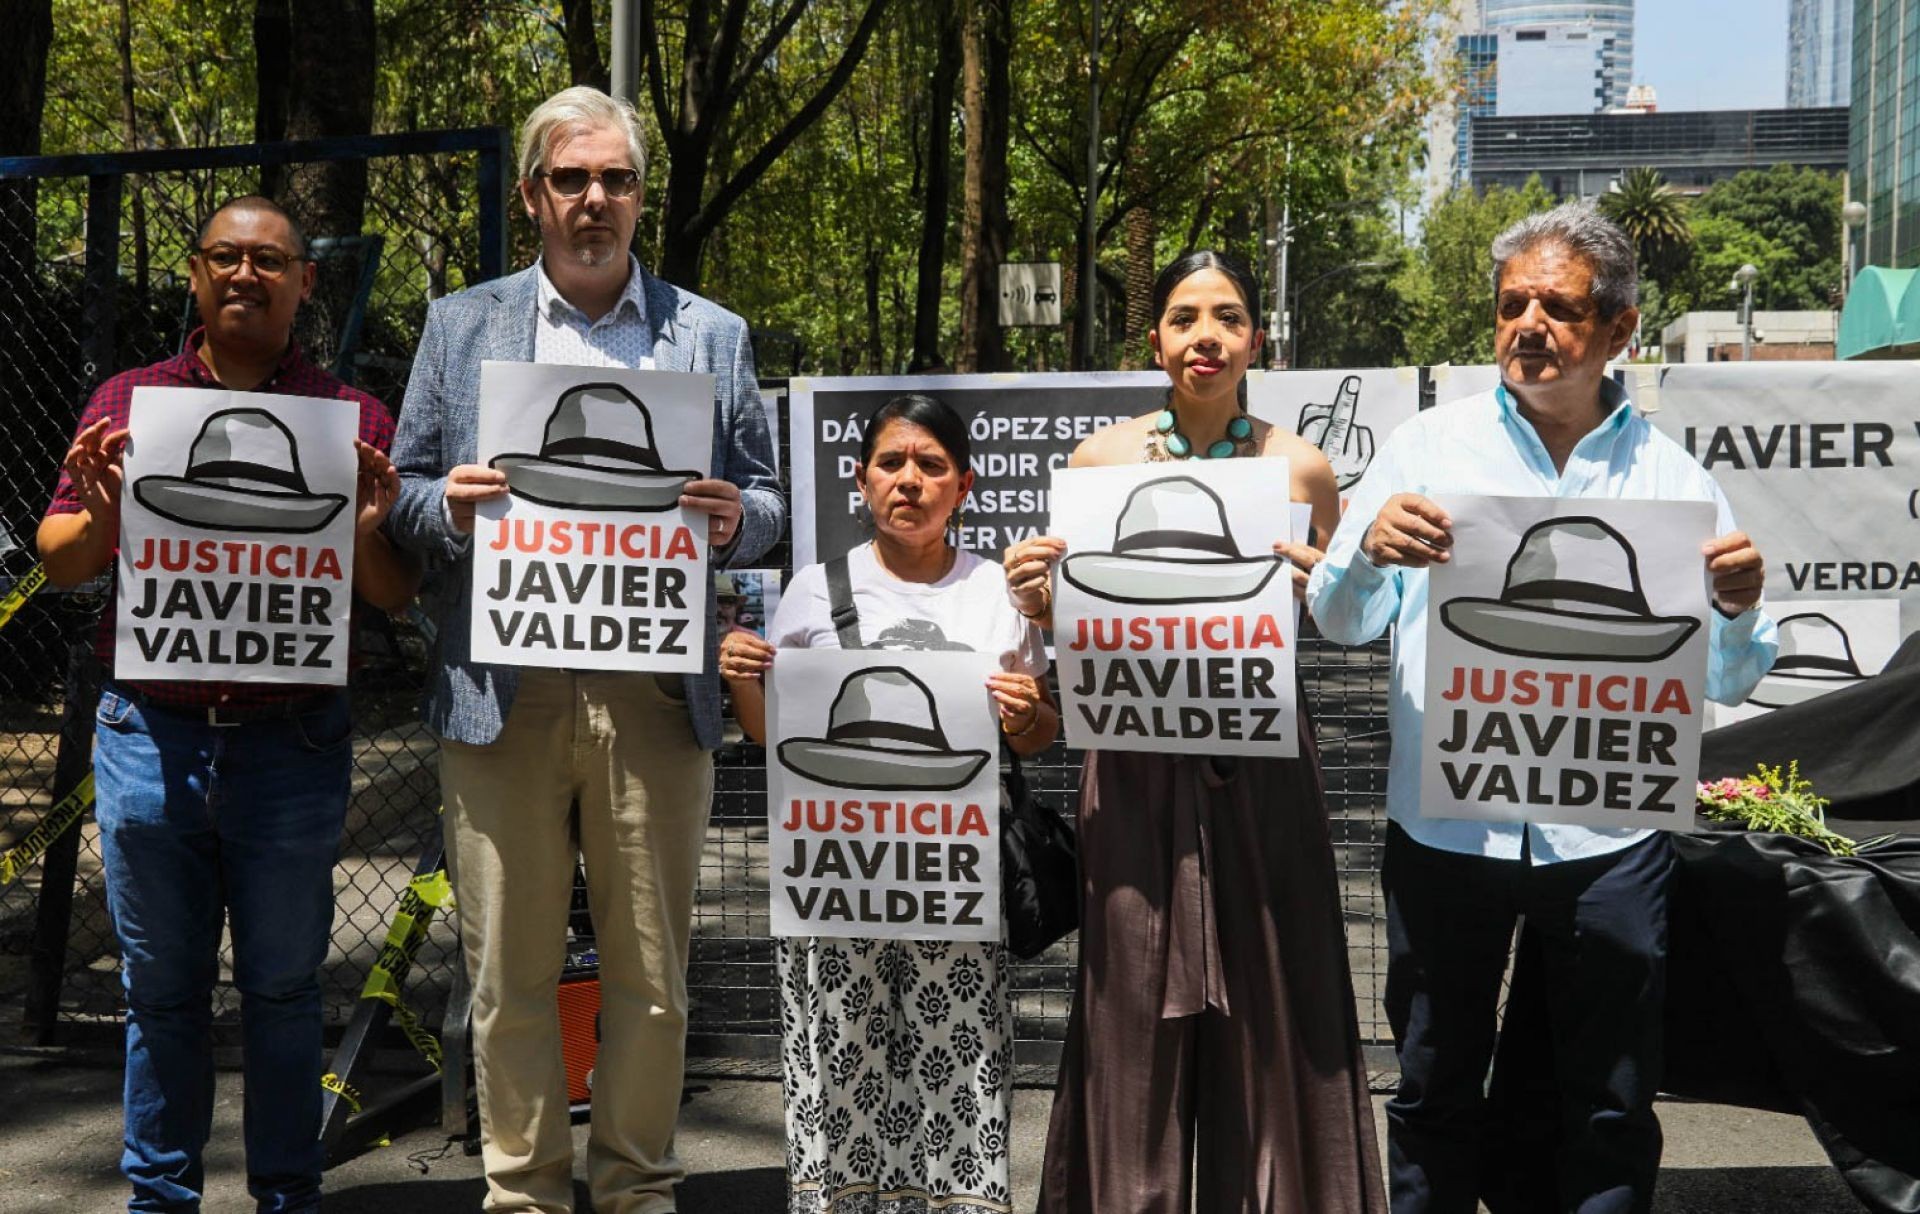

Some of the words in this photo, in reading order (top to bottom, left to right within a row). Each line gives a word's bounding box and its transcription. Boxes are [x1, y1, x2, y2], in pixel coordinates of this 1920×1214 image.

[968, 411, 1049, 441] ÓPEZ
[970, 453, 1039, 477] NDIR
[959, 489, 1051, 513] ASESI
[134, 538, 343, 580] JUSTICIA
[489, 518, 699, 560] JUSTICIA
[131, 578, 333, 626] JAVIER
[486, 559, 688, 609] JAVIER
[133, 627, 336, 668] VALDEZ
[488, 609, 690, 655] VALDEZ
[1069, 614, 1285, 652] JUSTICIA
[1072, 657, 1277, 699] JAVIER
[1441, 667, 1692, 715] JUSTICIA
[1077, 703, 1282, 742] VALDEZ
[1438, 709, 1678, 766] JAVIER
[1440, 761, 1680, 814] VALDEZ
[782, 799, 990, 836] JUSTICIA
[782, 838, 982, 883] JAVIER
[785, 885, 985, 926] VALDEZ
